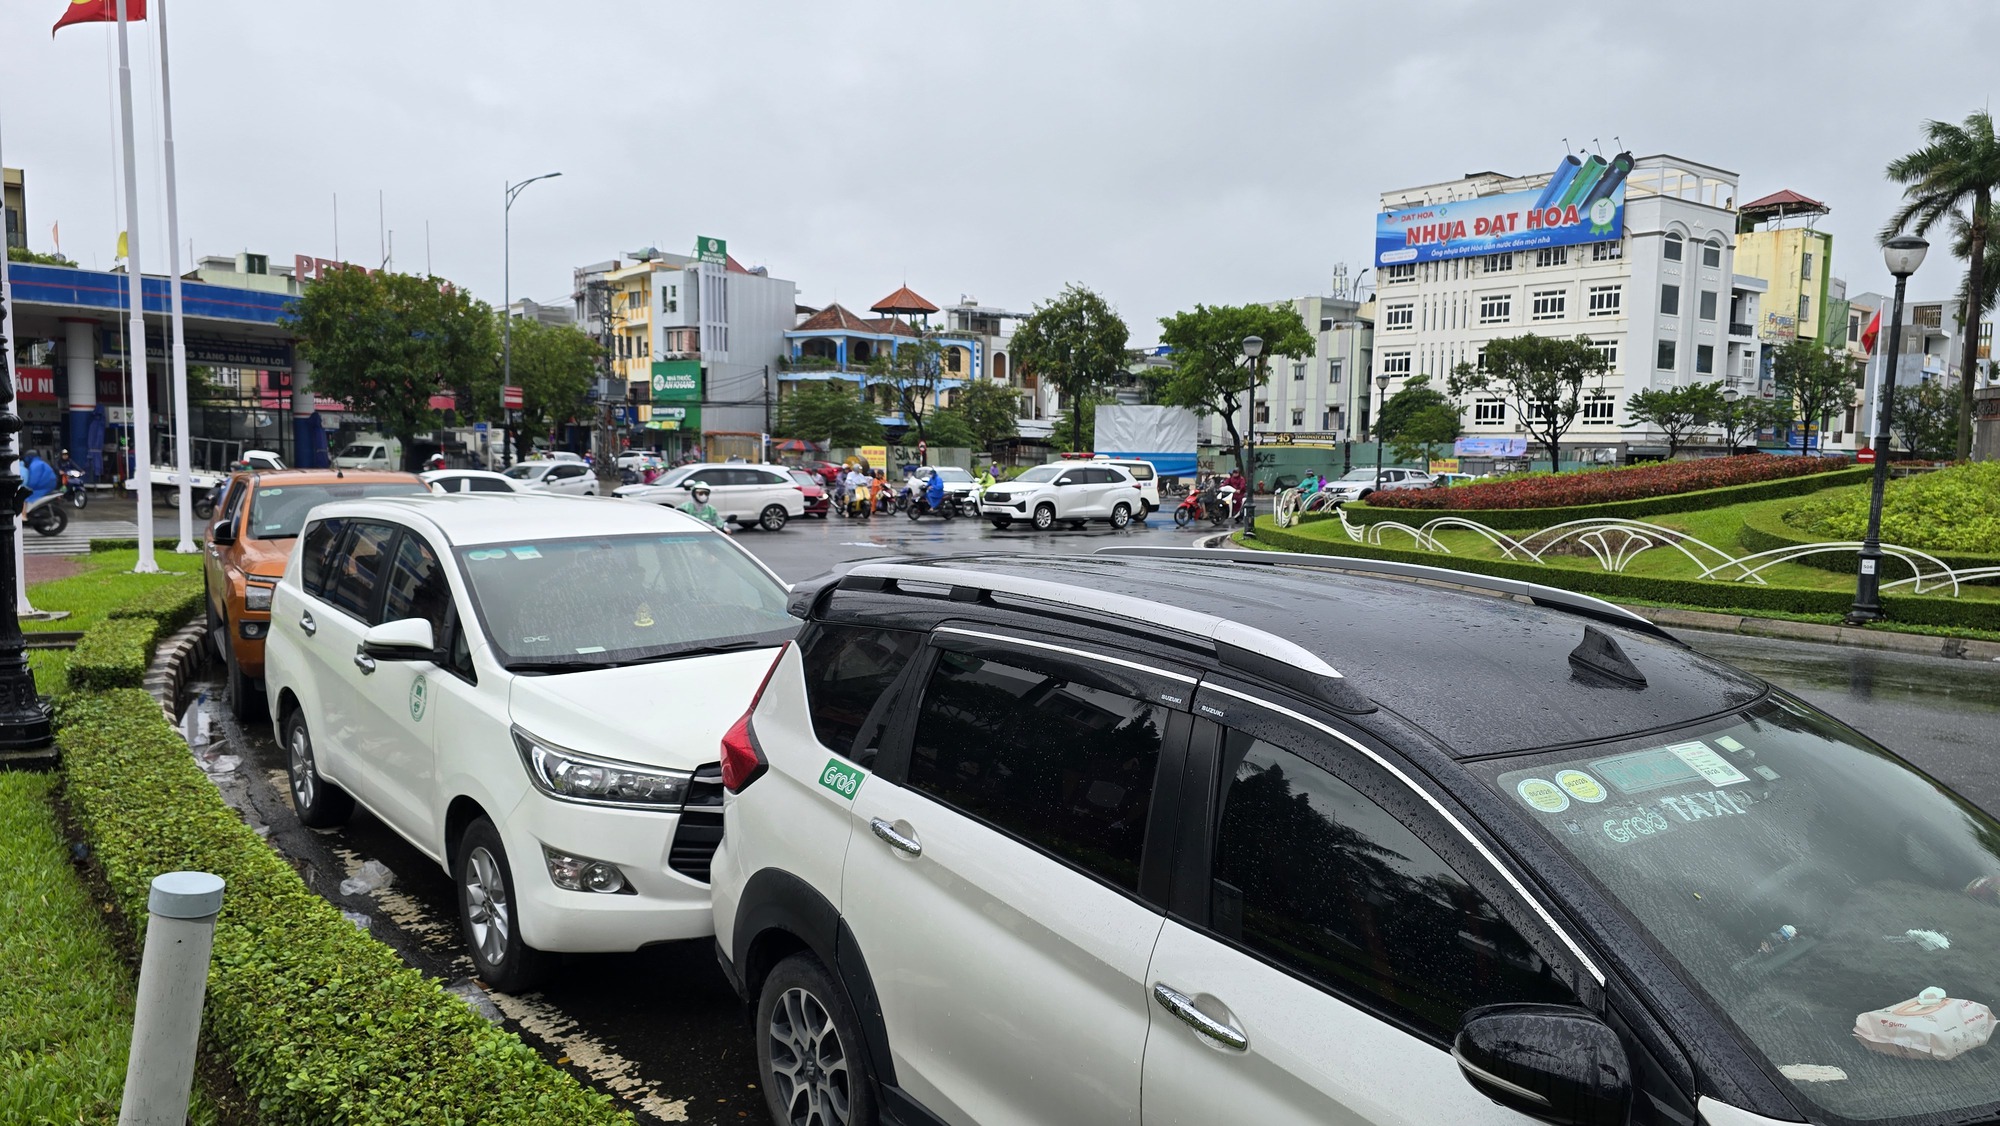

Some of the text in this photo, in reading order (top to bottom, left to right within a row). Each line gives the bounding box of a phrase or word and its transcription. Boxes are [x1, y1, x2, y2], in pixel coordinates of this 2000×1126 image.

[1406, 220, 1467, 246] NHỰA
[1473, 212, 1519, 238] ĐẠT
[1526, 201, 1580, 229] HÒA
[1161, 694, 1182, 704] SUZUKI
[1201, 705, 1224, 717] SUZUKI
[823, 766, 857, 795] Grab
[1603, 790, 1746, 843] Grab TAXI
[1888, 1020, 1908, 1029] gumi
